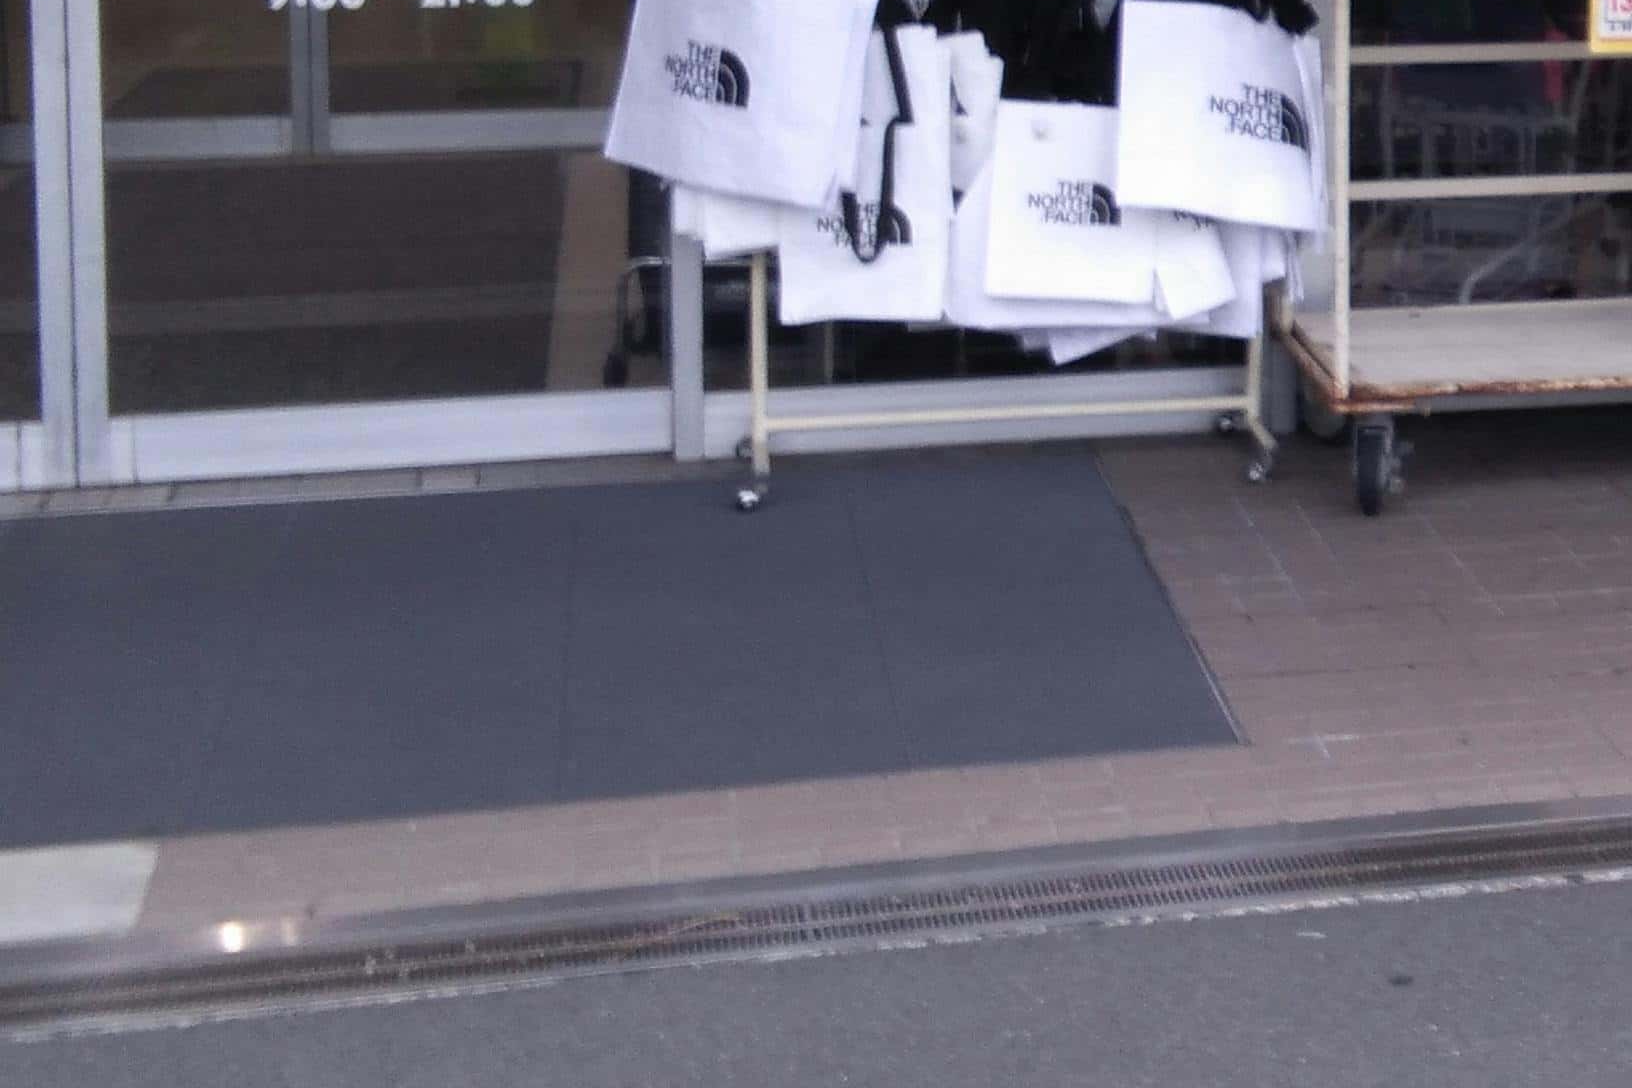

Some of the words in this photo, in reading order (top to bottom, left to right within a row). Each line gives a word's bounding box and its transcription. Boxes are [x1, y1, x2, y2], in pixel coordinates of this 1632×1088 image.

[1243, 83, 1281, 106] THE
[1209, 95, 1281, 128] NORTH
[1229, 112, 1281, 143] FACE
[1057, 180, 1091, 196] THE
[1027, 193, 1091, 211] NORTH
